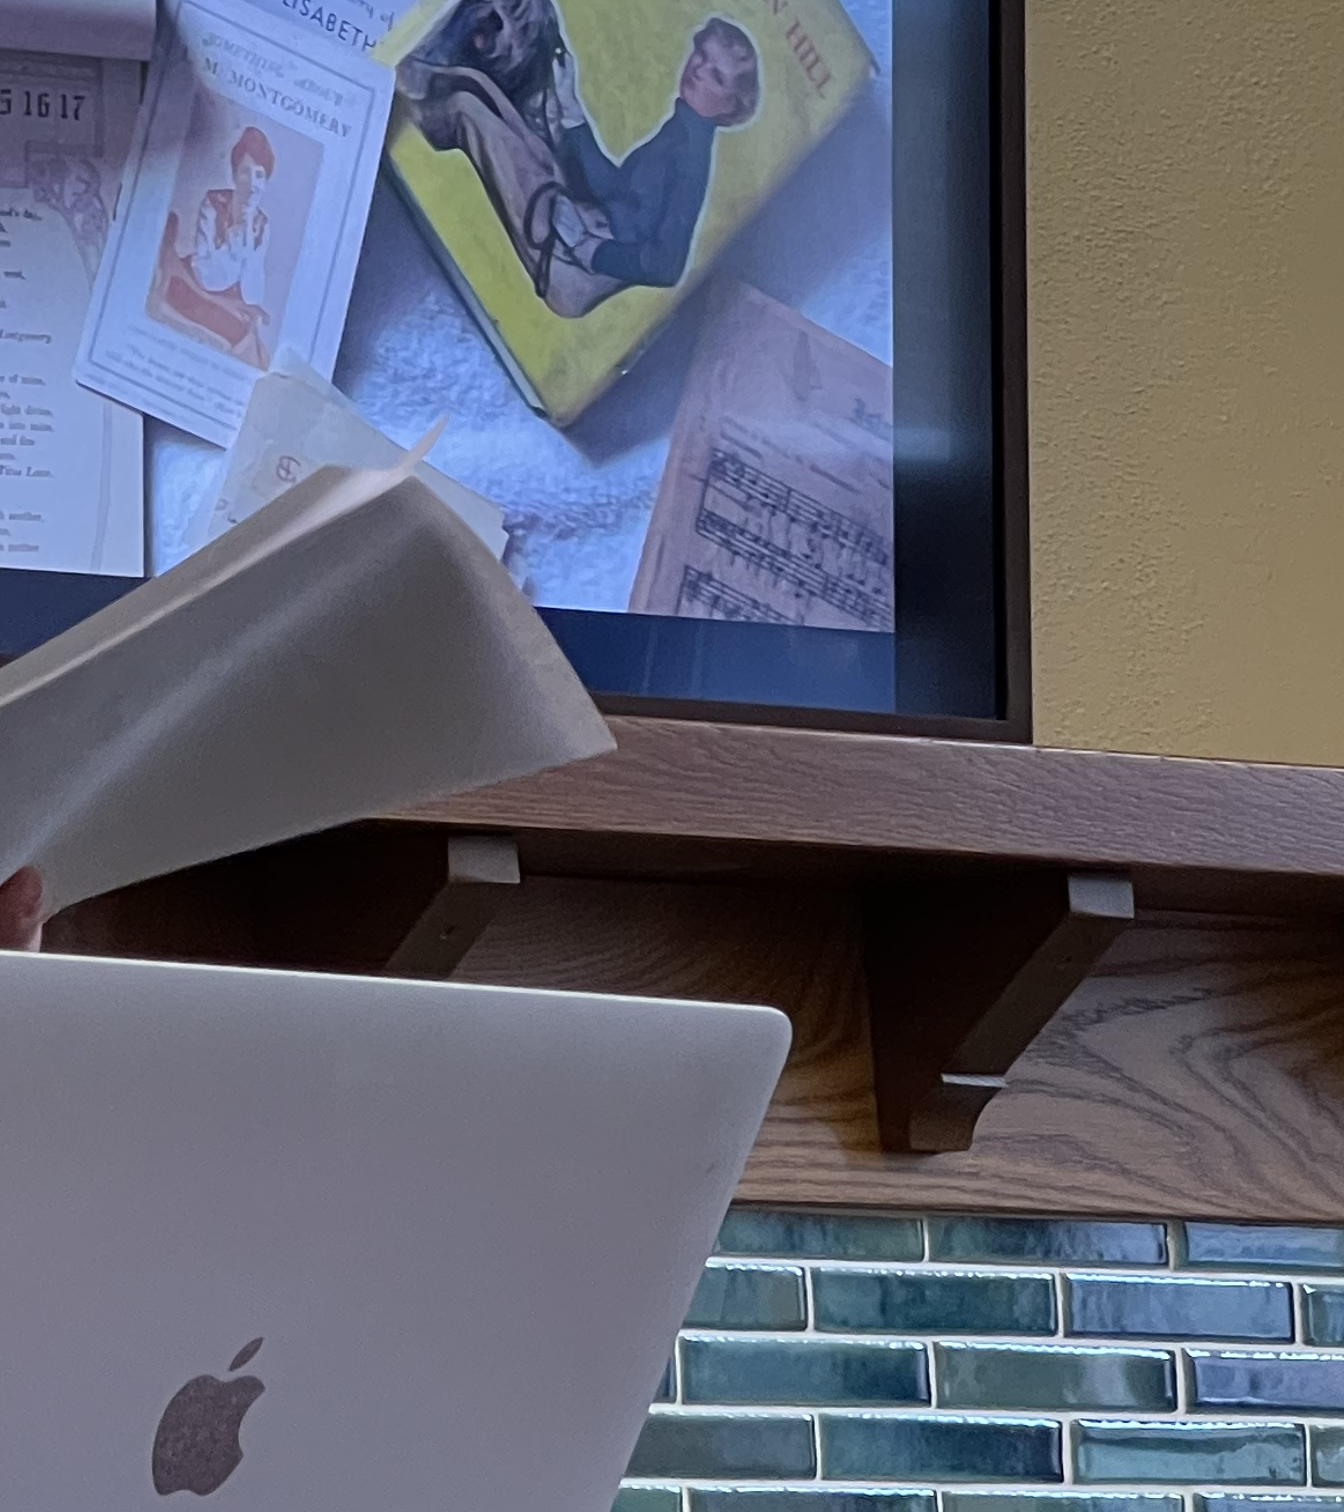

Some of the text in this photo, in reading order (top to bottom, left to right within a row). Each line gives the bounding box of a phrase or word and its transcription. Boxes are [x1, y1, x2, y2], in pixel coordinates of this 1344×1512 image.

[785, 18, 831, 99] HILL
[24, 91, 49, 118] 16
[60, 94, 85, 121] 17
[229, 70, 352, 137] MONTGOMERY
